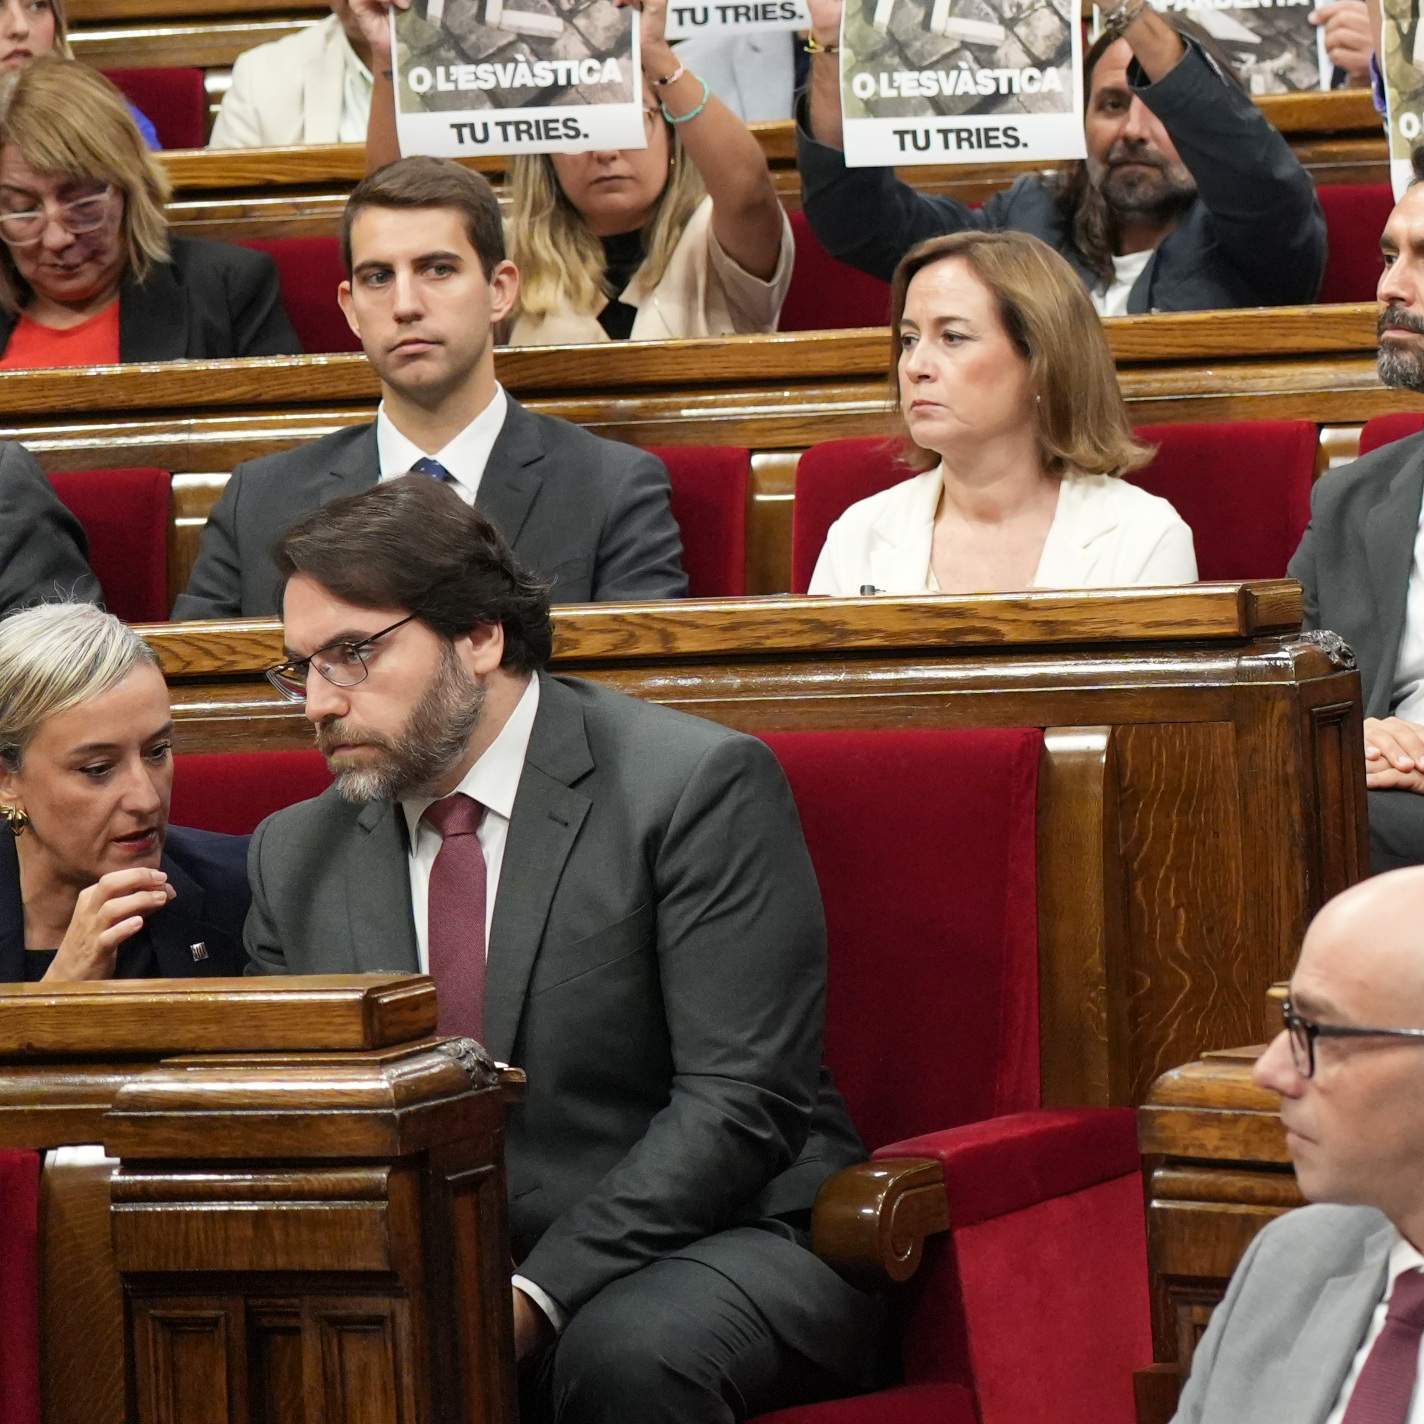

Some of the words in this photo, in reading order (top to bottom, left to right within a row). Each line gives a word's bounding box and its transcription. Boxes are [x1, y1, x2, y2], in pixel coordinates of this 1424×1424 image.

[408, 66, 432, 92] O
[436, 54, 624, 92] L'ESVÀSTICA
[853, 72, 876, 100] O
[880, 62, 1064, 98] L'ESVÀSTICA
[450, 122, 489, 144] TU
[494, 117, 589, 143] TRIES.
[893, 129, 930, 151] TU
[937, 126, 1028, 150] TRIES.
[1400, 112, 1422, 140] O
